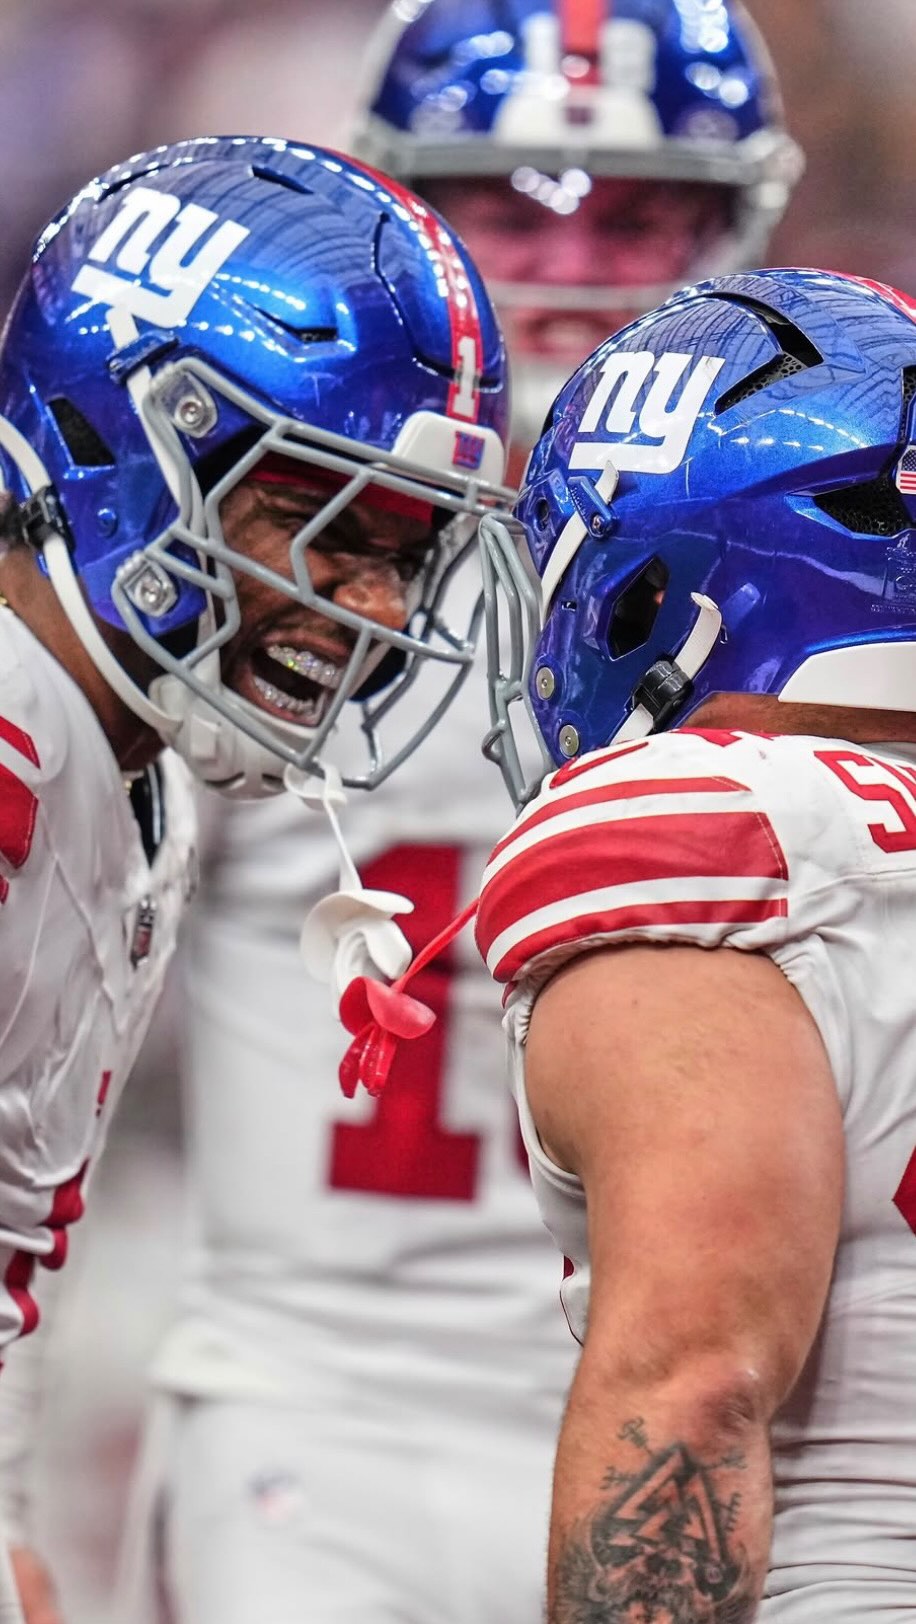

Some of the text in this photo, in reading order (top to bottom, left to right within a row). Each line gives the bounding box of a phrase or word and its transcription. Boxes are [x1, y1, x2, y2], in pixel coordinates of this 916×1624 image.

[453, 336, 476, 417] 1
[568, 351, 726, 474] ny
[331, 843, 530, 1202] 1
